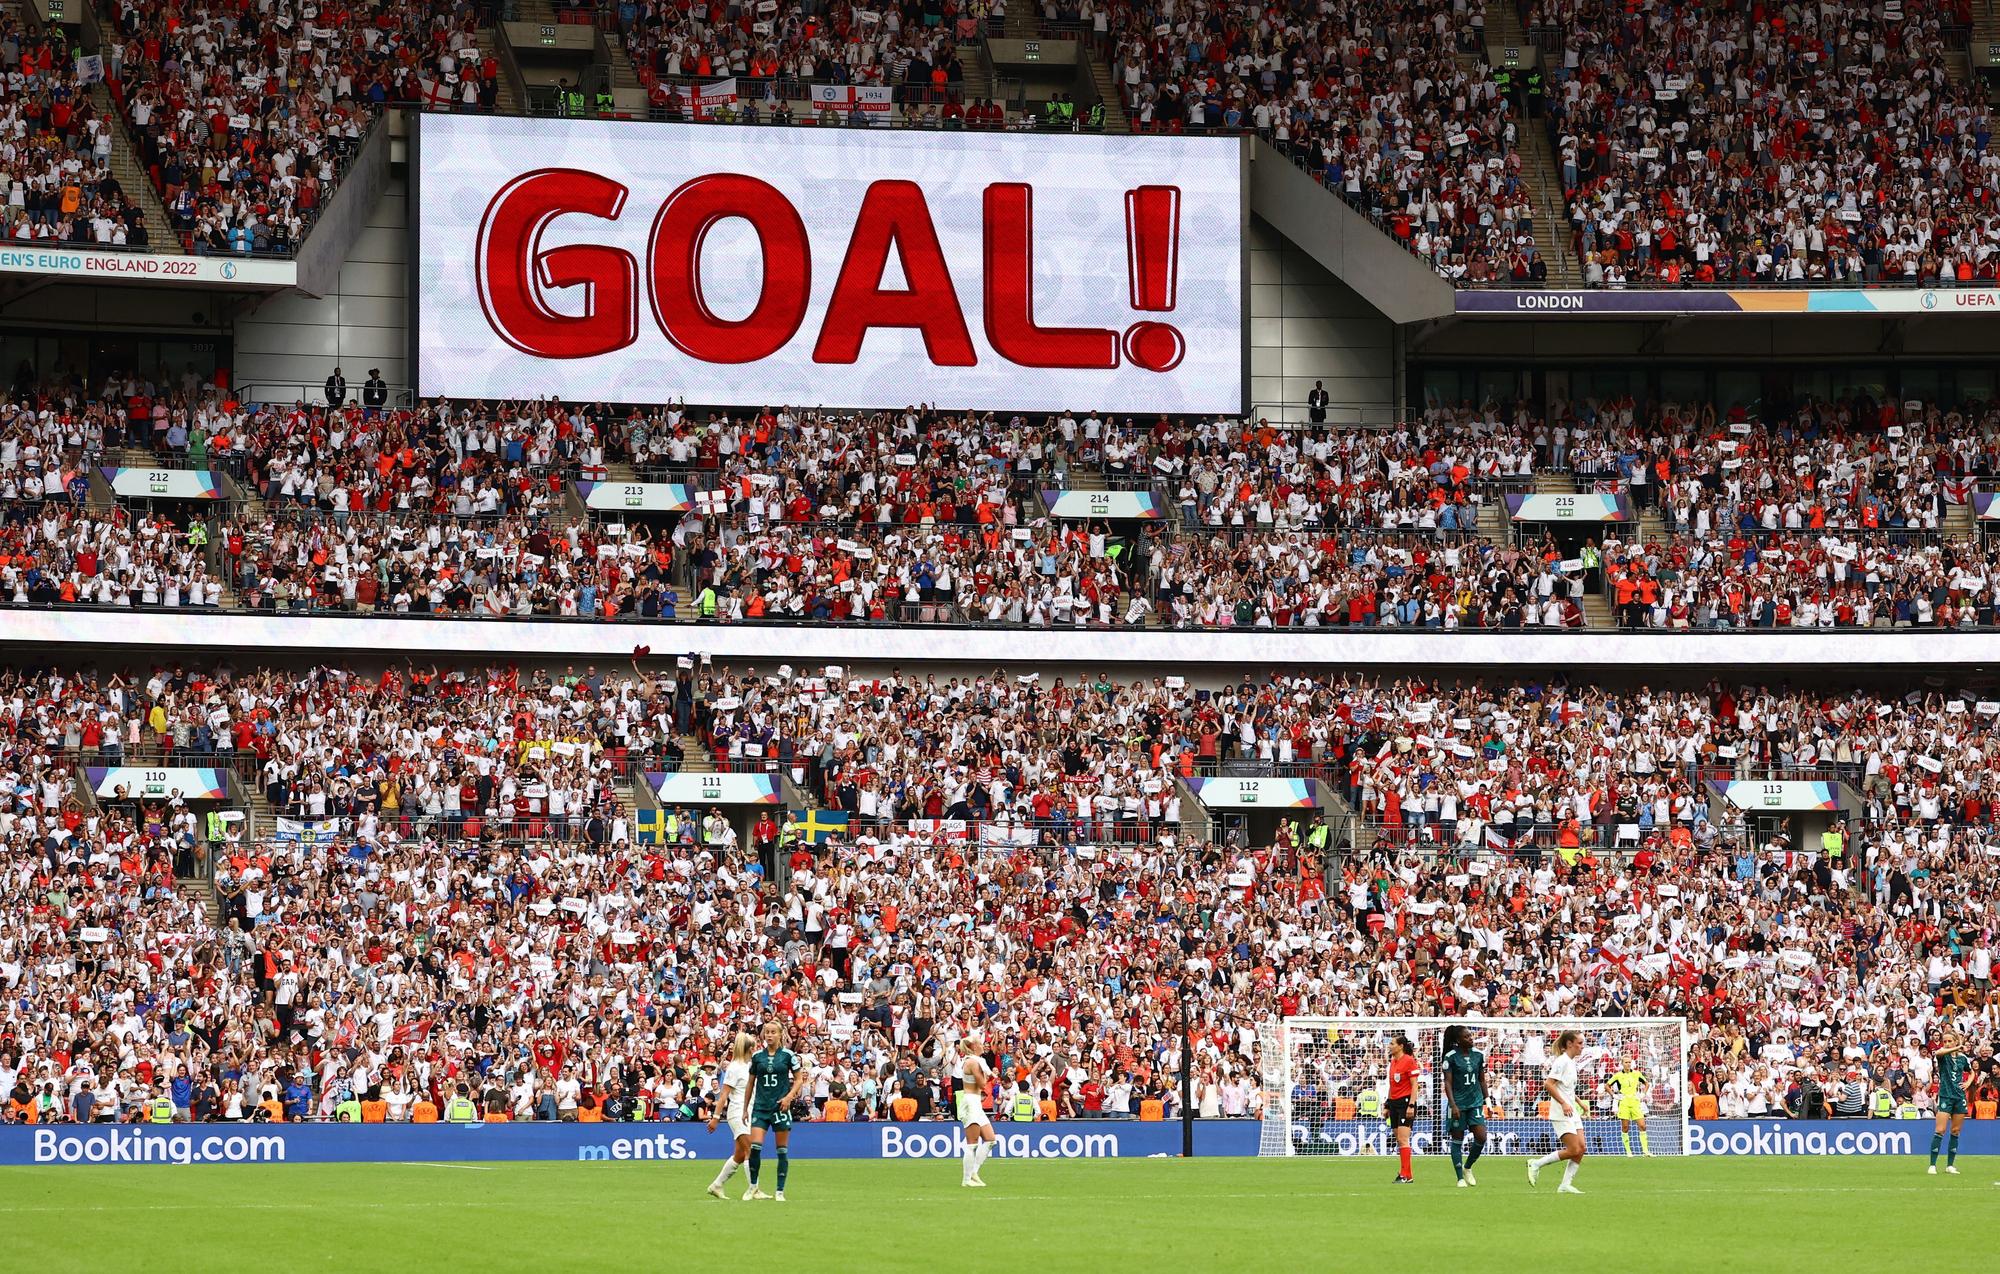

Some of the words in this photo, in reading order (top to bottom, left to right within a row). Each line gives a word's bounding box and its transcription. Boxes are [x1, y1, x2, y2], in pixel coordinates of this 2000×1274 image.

[49, 1, 63, 9] 512
[541, 26, 555, 35] 513
[1025, 43, 1039, 51] 514
[1505, 50, 1519, 58] 515
[1, 253, 34, 267] EN'S
[39, 255, 81, 269] EURO
[86, 258, 158, 273] ENGLAND
[163, 262, 197, 275] 2022
[475, 167, 1185, 373] GOAL!
[1517, 295, 1583, 308] LONDON
[1956, 294, 1995, 305] UEFA
[149, 473, 168, 482] 212
[625, 486, 643, 495] 213
[1090, 494, 1109, 503] 214
[1555, 497, 1575, 506] 215
[145, 771, 166, 782] 110
[702, 777, 721, 787] 111
[1239, 782, 1259, 791] 112
[1763, 785, 1783, 794] 113
[763, 1074, 778, 1087] 15
[1464, 1073, 1475, 1086] 14
[1951, 1072, 1957, 1081] 3
[774, 1110, 787, 1124] 15
[882, 1126, 1118, 1157] Bookng.com
[1689, 1124, 1911, 1156] Booking.com
[35, 1128, 285, 1165] Booking.com
